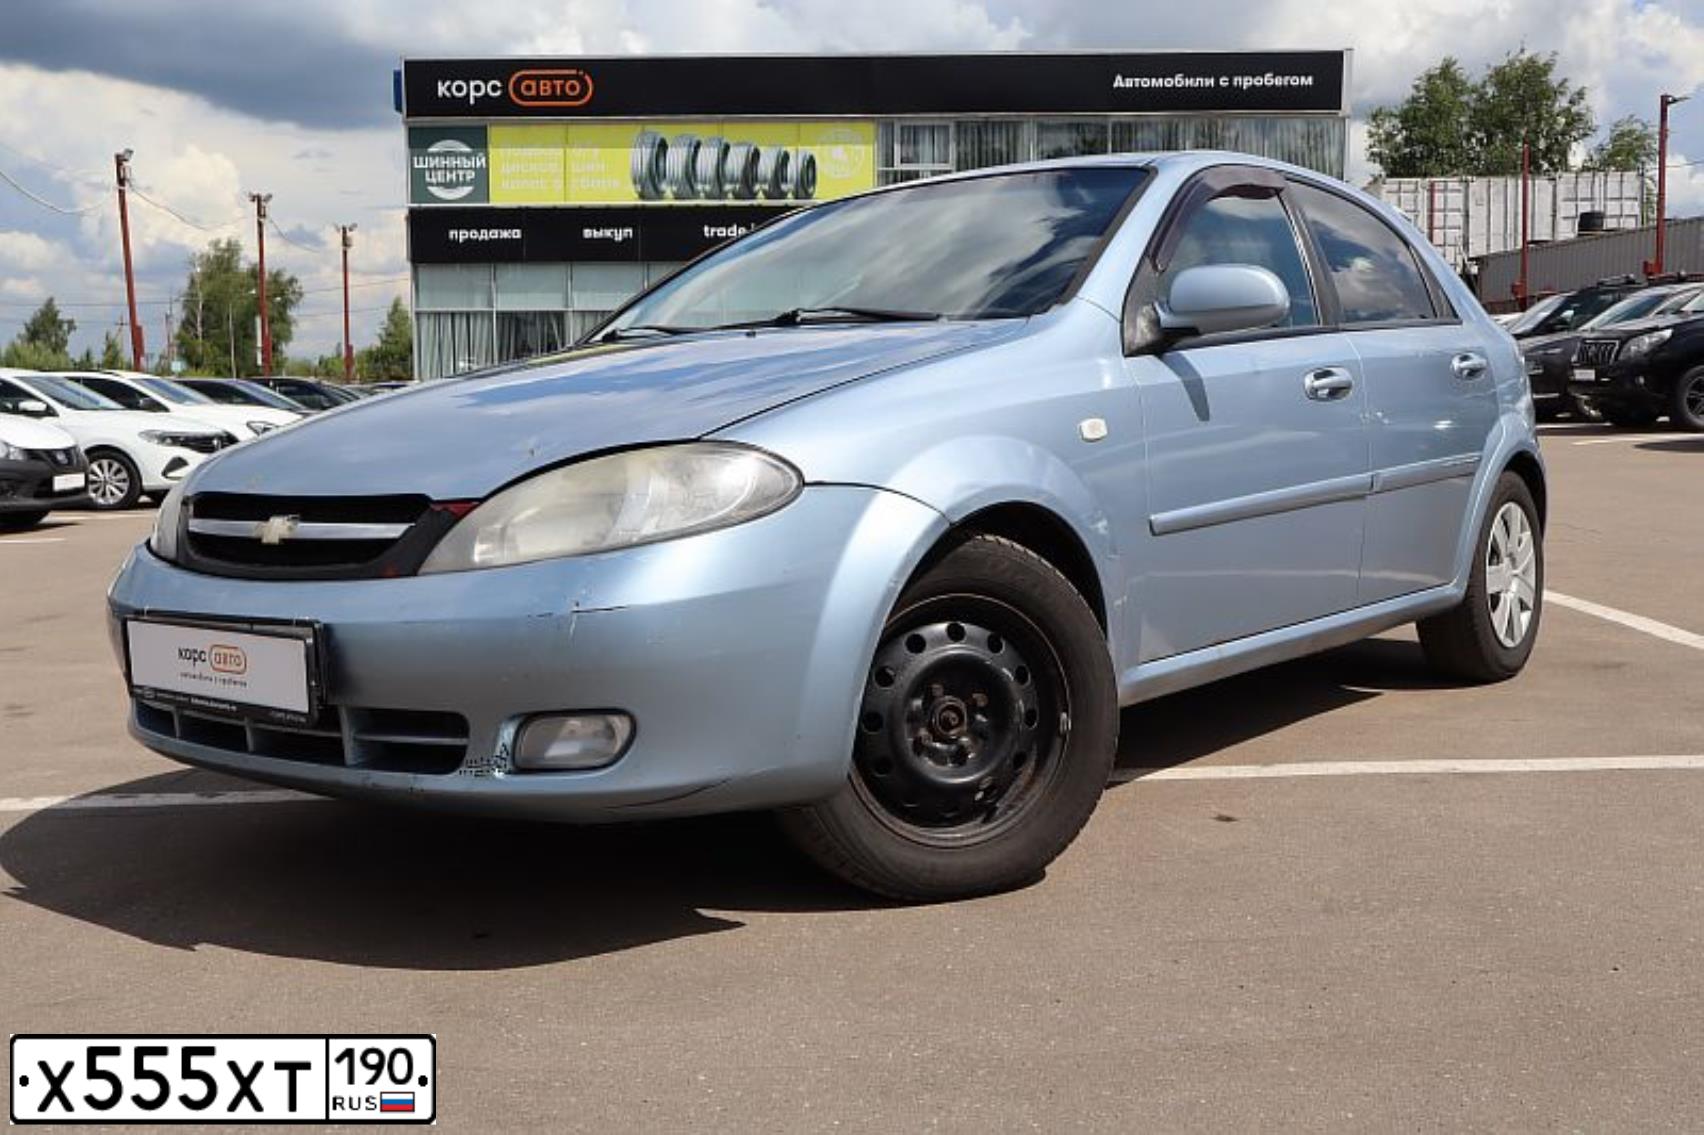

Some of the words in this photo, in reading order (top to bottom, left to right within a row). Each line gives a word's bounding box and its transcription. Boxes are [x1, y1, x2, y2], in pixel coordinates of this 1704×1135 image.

[1113, 74, 1215, 89] Автомобили
[1219, 78, 1229, 87] с
[1233, 73, 1313, 90] пробегом
[437, 77, 503, 105] корс
[520, 80, 582, 97] авто
[413, 153, 486, 169] ШИННЫЙ
[425, 169, 476, 185] ЦЕНТР
[448, 227, 522, 241] продажа
[582, 227, 634, 241] выкуп
[178, 647, 207, 668] корс
